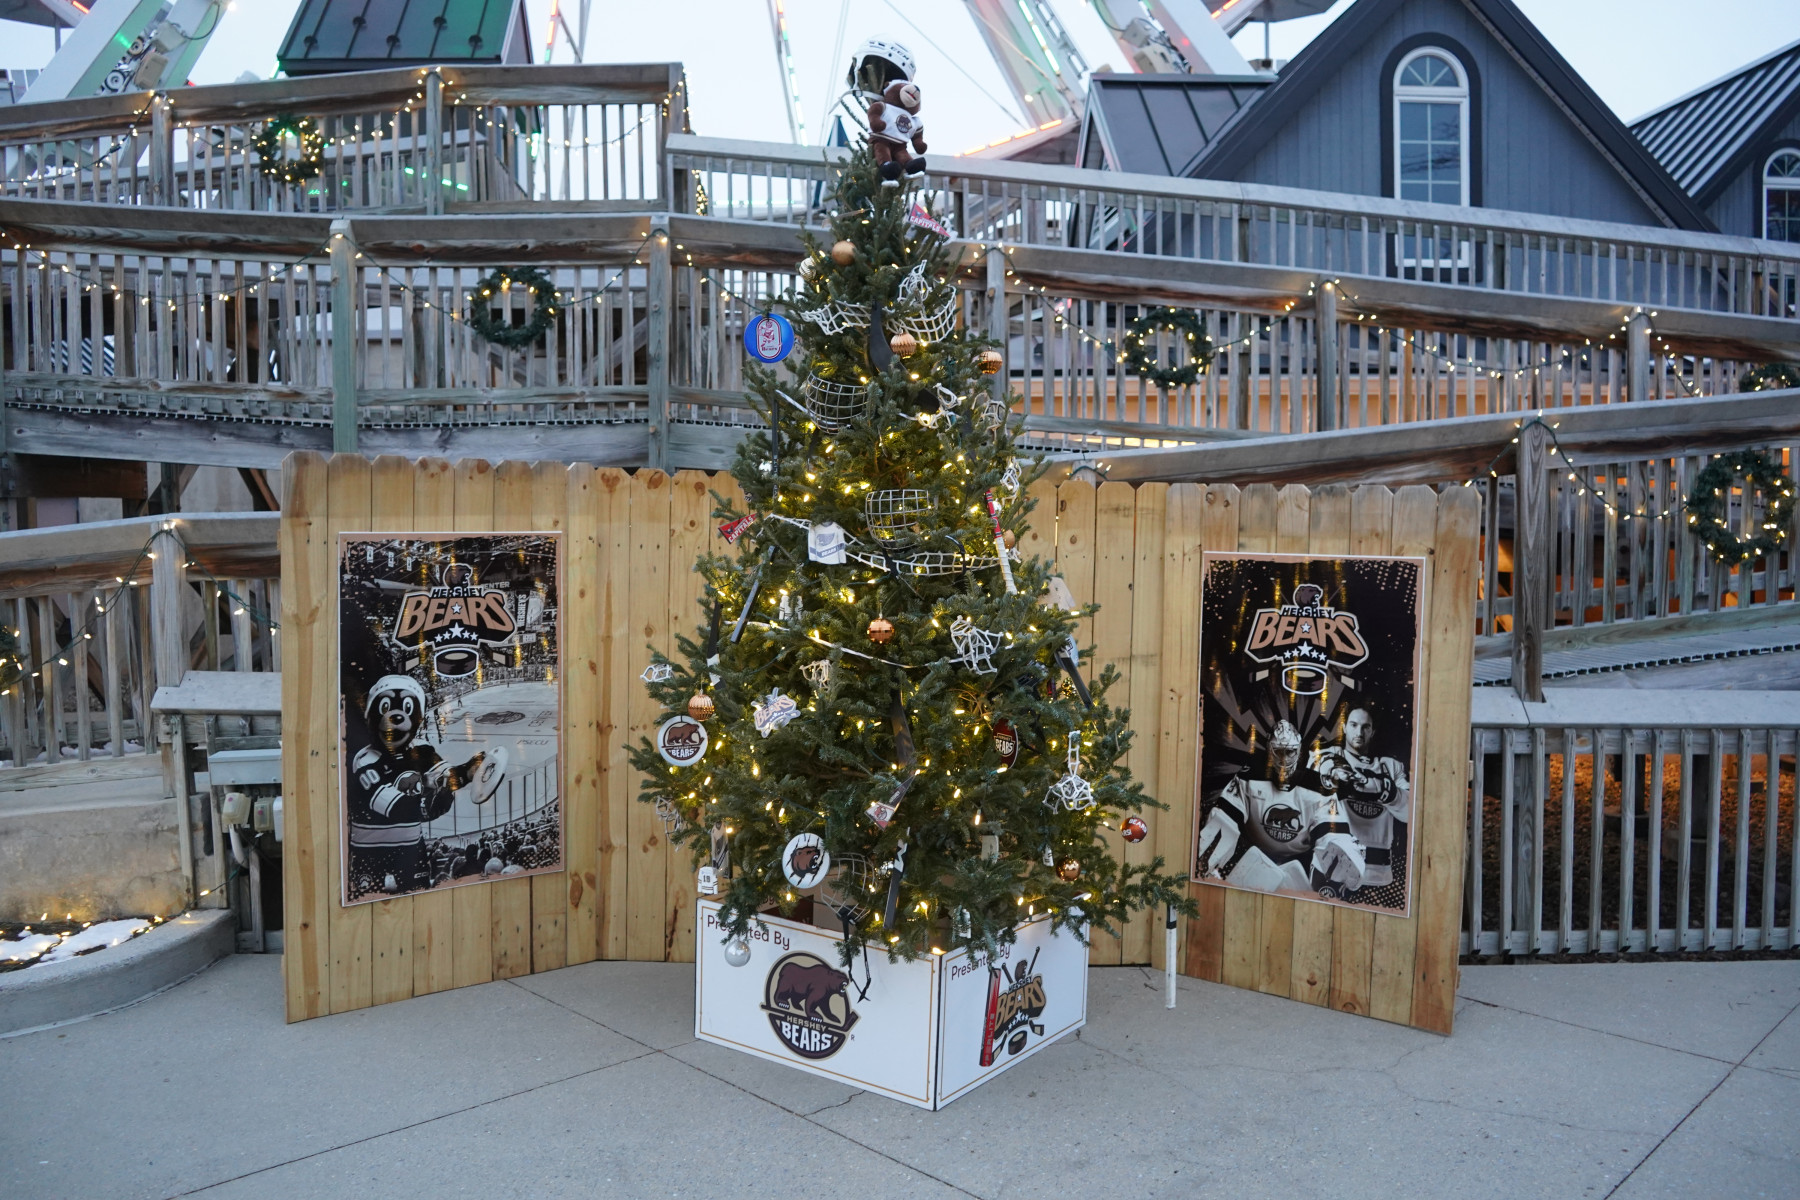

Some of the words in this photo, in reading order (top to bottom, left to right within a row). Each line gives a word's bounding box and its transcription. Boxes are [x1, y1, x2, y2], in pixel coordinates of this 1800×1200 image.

[910, 215, 940, 232] CAPITALS
[728, 516, 754, 543] CAPITALS
[431, 588, 483, 598] HERSHEY
[398, 592, 514, 638] BEARS
[1282, 607, 1333, 618] HERSHEY
[1250, 611, 1365, 657] BEARS
[756, 696, 795, 727] BEARS
[671, 749, 694, 758] BEARS
[995, 739, 1014, 754] BEARS
[1353, 803, 1379, 816] BEARS
[1269, 830, 1294, 841] BEARS
[774, 931, 790, 951] By
[1000, 944, 1011, 959] By
[1008, 976, 1032, 993] HERSHEY
[994, 976, 1046, 1031] BEARS
[786, 1014, 827, 1032] HERSHEY
[781, 1021, 833, 1052] BEARS
